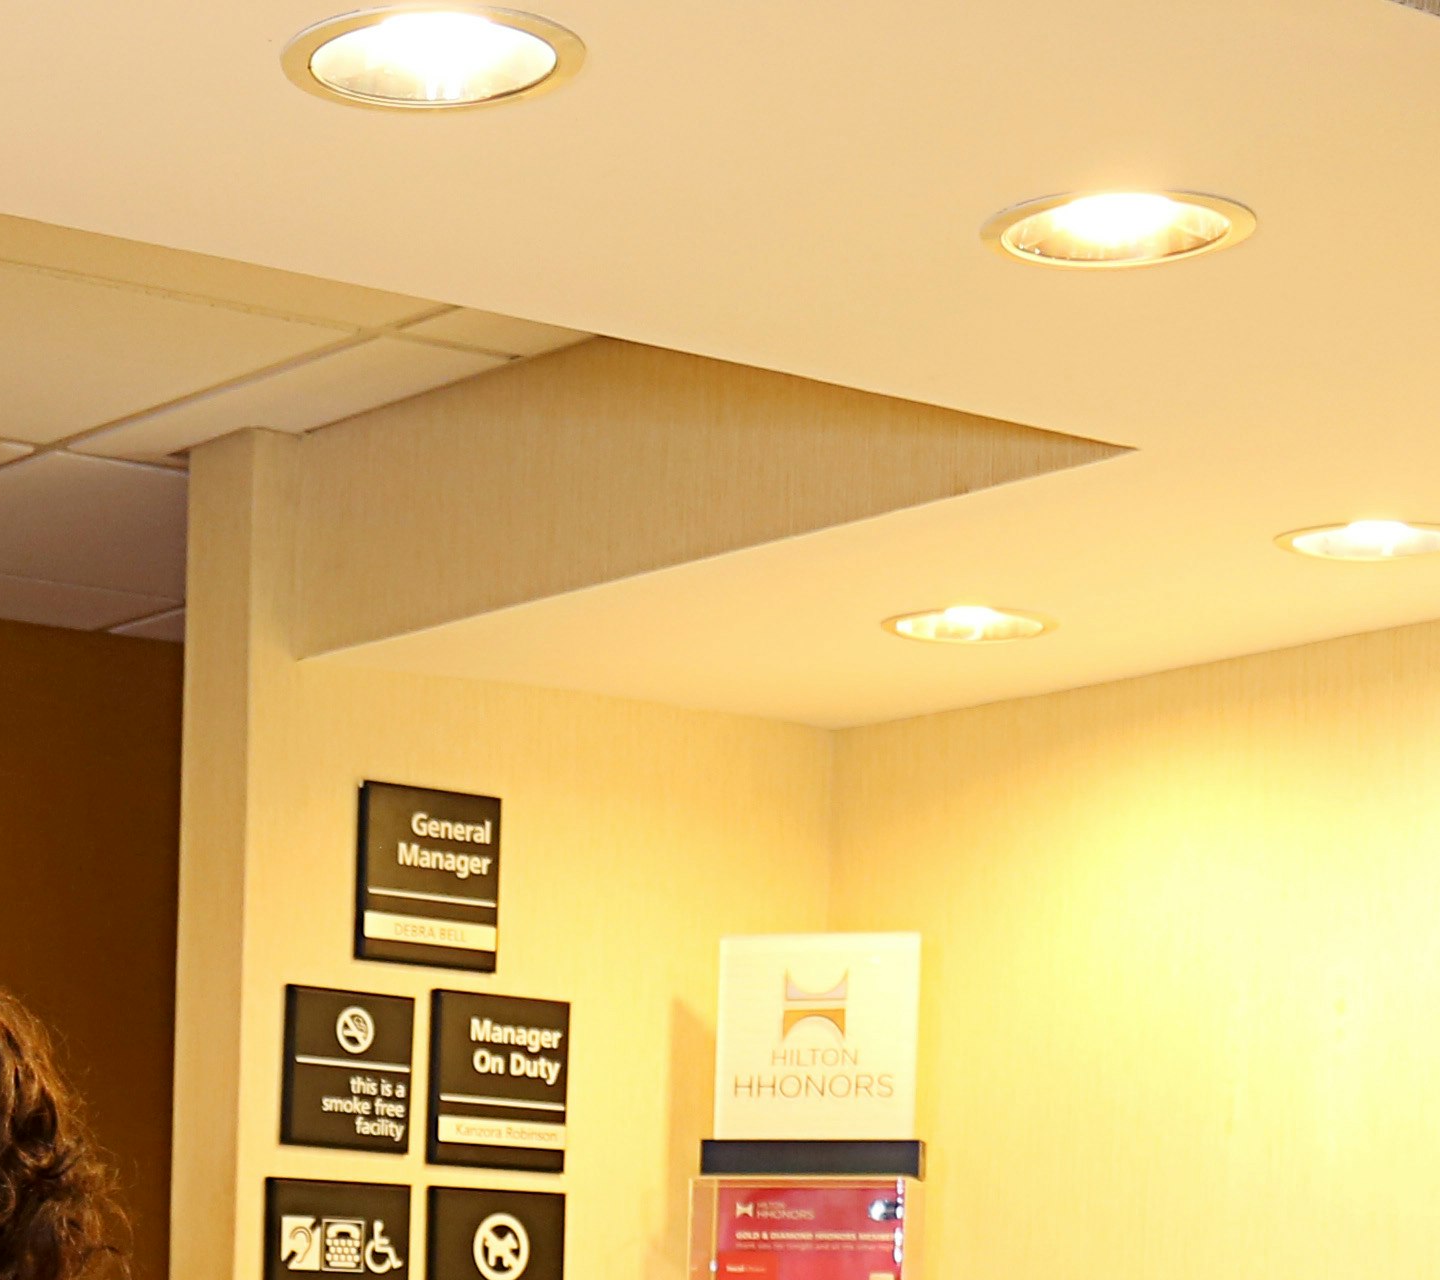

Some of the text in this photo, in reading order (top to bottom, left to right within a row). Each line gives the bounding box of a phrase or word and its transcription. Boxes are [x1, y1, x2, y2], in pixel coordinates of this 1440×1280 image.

[411, 811, 492, 845] General
[398, 841, 492, 879] Manager
[394, 922, 466, 942] DEBRA BELL
[470, 1017, 563, 1054] Manager
[473, 1048, 561, 1086] On Duty
[771, 1048, 859, 1067] HILTON
[349, 1074, 406, 1098] this is a
[733, 1073, 895, 1099] HHONORS
[322, 1096, 405, 1118] smoke free
[355, 1116, 405, 1142] facility
[506, 1126, 558, 1141] Robinson
